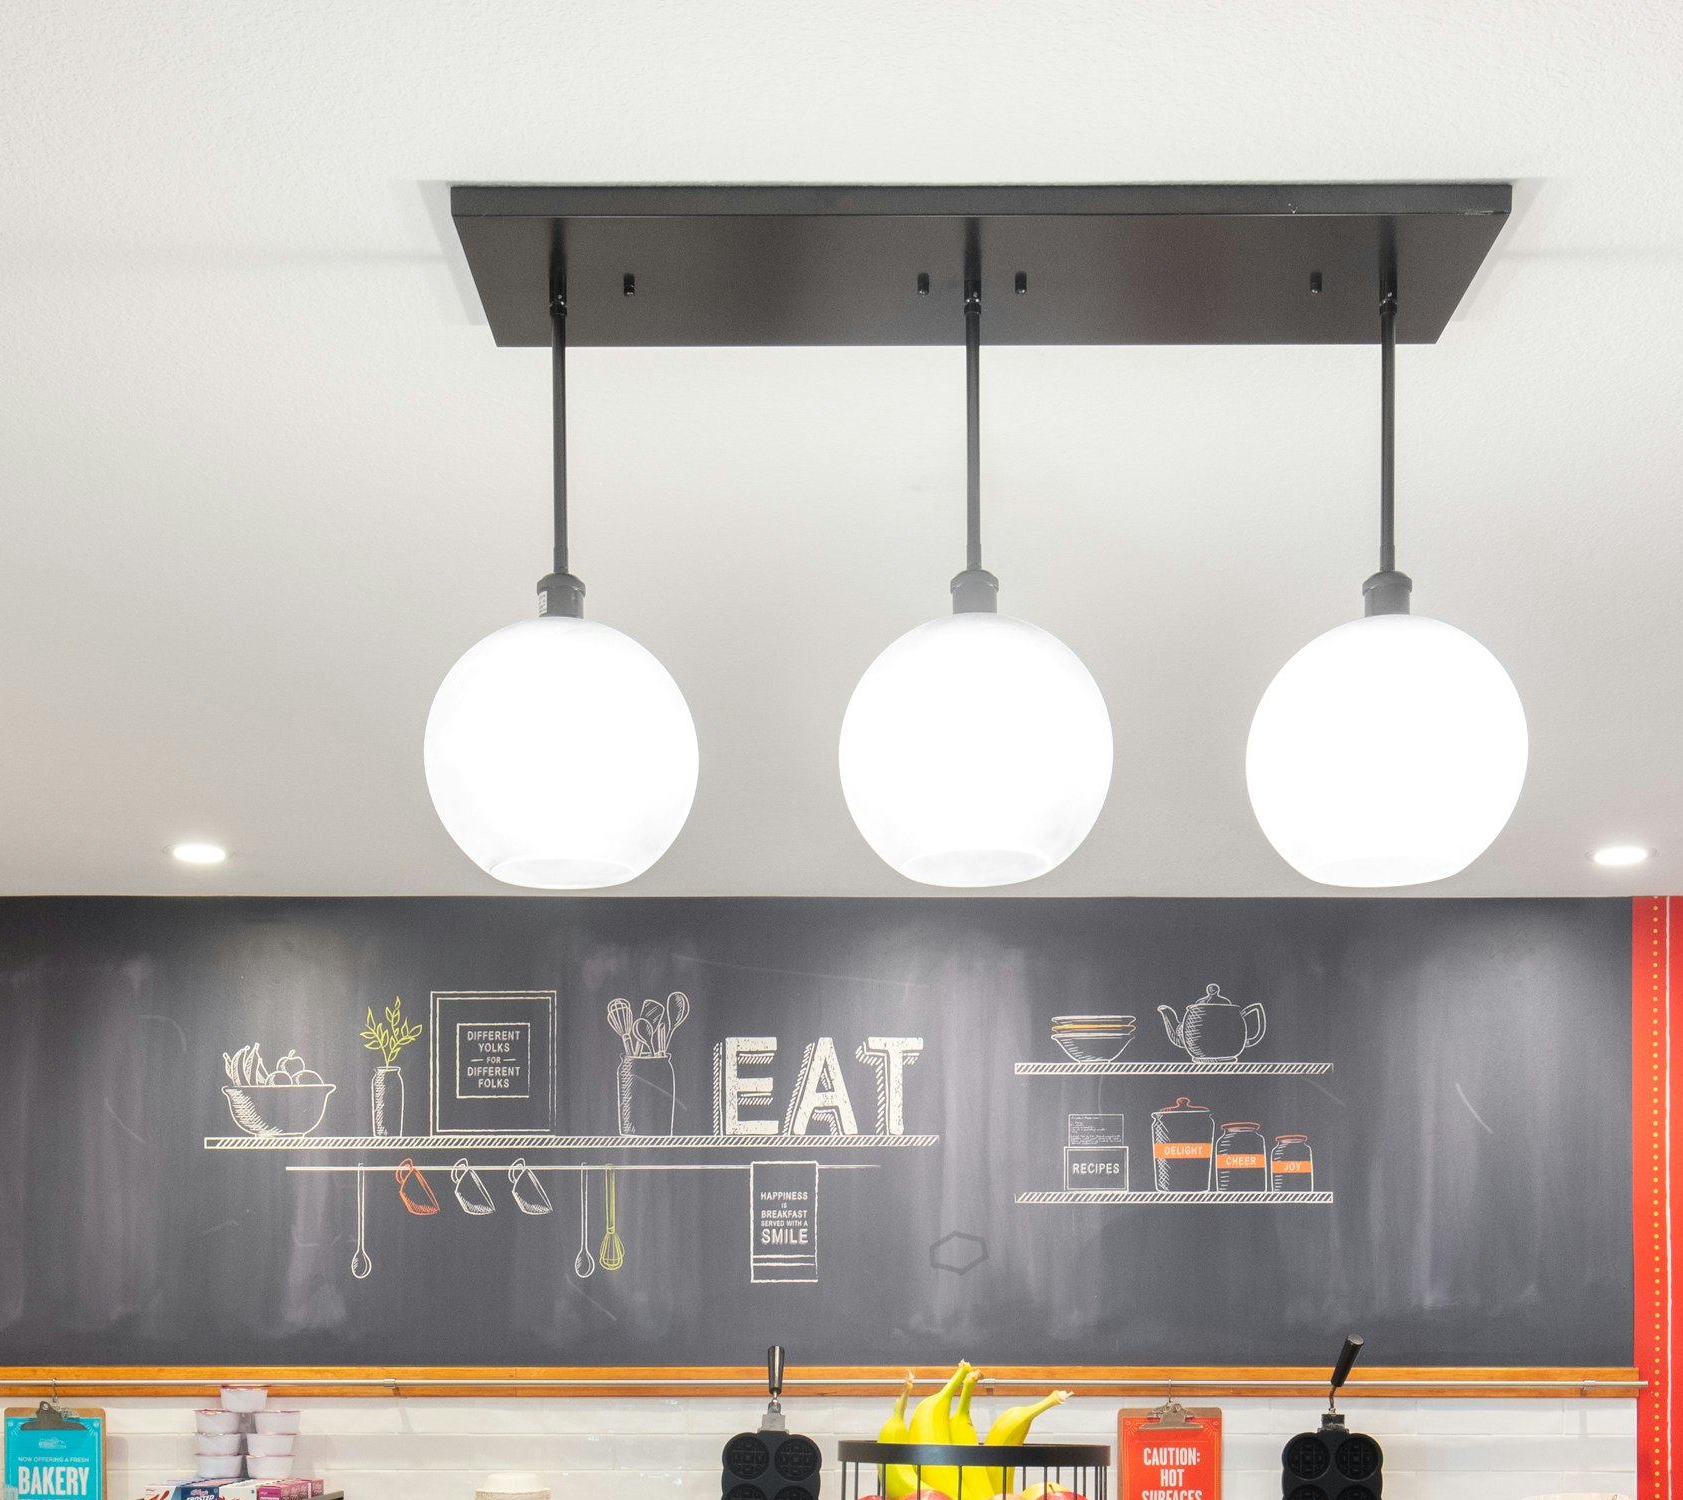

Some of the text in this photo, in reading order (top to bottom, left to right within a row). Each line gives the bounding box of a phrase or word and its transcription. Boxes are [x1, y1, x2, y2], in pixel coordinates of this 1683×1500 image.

[467, 1030, 521, 1041] DIFFERENT
[478, 1042, 511, 1053] YOLKS
[486, 1056, 501, 1064] FOR
[467, 1066, 521, 1077] DIFFERENT
[478, 1078, 510, 1089] FOLKS
[713, 1036, 924, 1136] EAT
[1164, 1145, 1204, 1156] DELIGHT
[1225, 1156, 1257, 1166] CHEER
[1072, 1162, 1120, 1175] RECIPES
[1284, 1162, 1302, 1172] JOY
[761, 1191, 808, 1201] HAPPINESS
[761, 1210, 808, 1219] BREAKFAST
[761, 1228, 808, 1245] SMILE
[1143, 1447, 1201, 1466] CAUTION:
[18, 1465, 90, 1496] BAKERY
[1160, 1468, 1185, 1488] HOT
